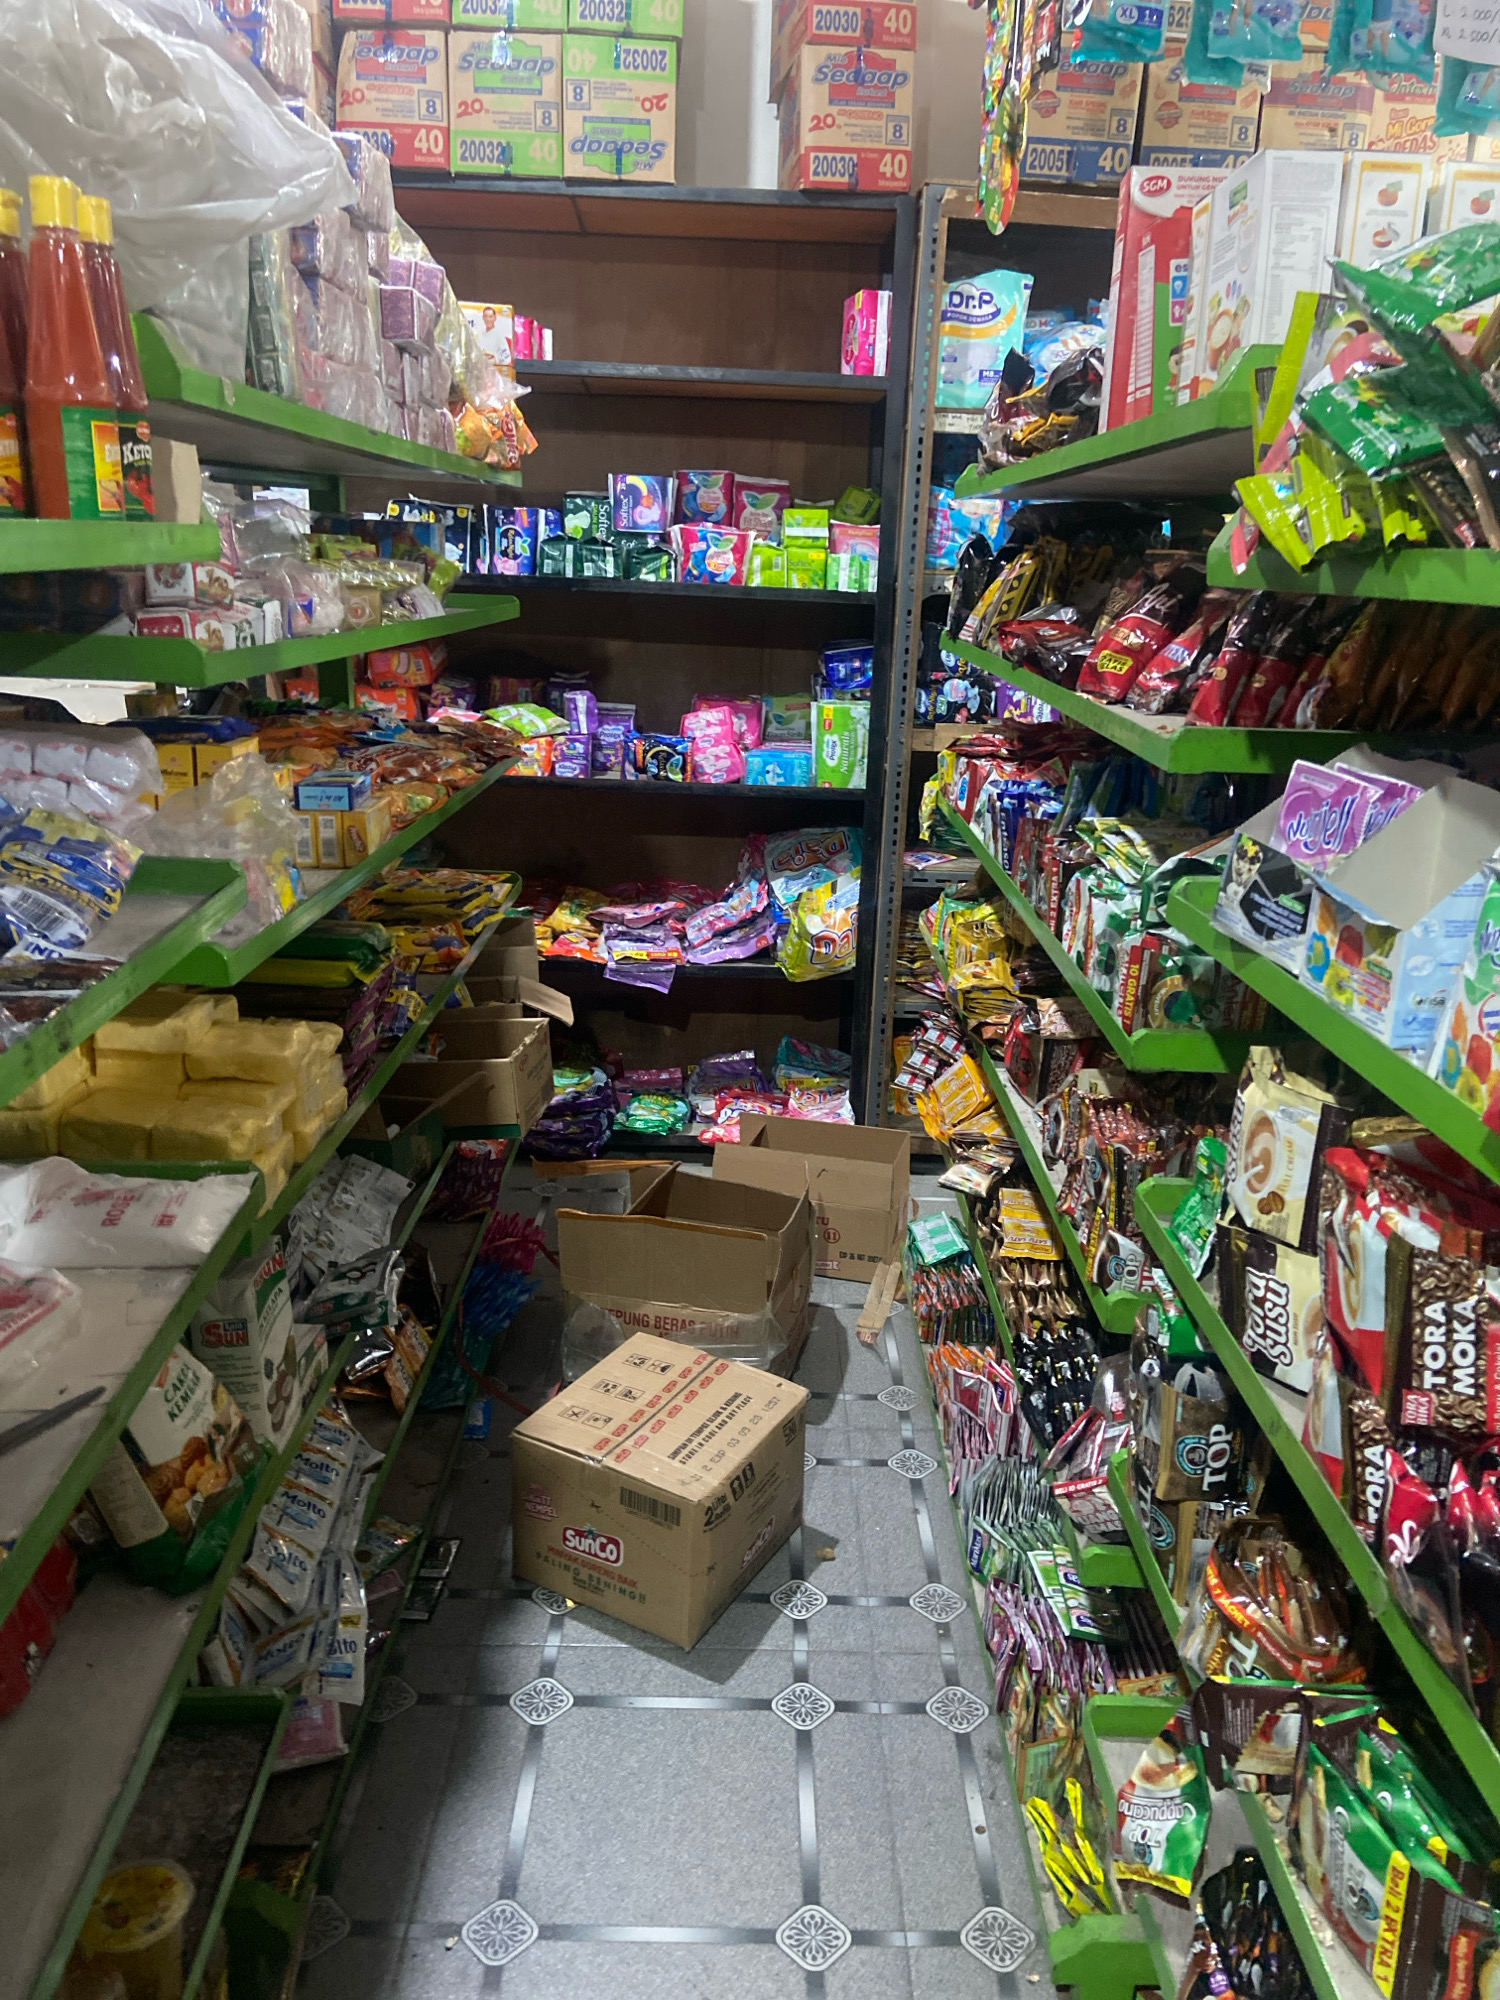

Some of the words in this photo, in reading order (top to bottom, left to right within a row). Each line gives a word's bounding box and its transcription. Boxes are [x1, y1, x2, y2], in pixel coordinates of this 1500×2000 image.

[815, 9, 859, 33] 20030
[884, 8, 911, 34] 40
[1120, 5, 1137, 18] XL
[352, 45, 440, 66] edaap
[622, 49, 667, 72] 20032
[812, 64, 910, 91] Sedaap
[425, 98, 437, 115] 8
[573, 85, 583, 103] 8
[640, 93, 668, 112] 20
[456, 98, 484, 118] 20
[541, 109, 552, 127] 8
[808, 114, 836, 132] 20
[892, 123, 903, 139] 8
[1116, 117, 1127, 133] 8
[1237, 125, 1249, 141] 8
[414, 129, 444, 154] 40
[459, 139, 504, 163] 20032
[528, 138, 558, 162] 40
[569, 135, 667, 161] Sedaap
[1349, 131, 1359, 148] 8
[812, 154, 856, 177] 20030
[879, 153, 908, 178] 40
[1098, 147, 1129, 172] 40
[1142, 178, 1168, 191] SGM
[841, 731, 850, 774] Naturals
[1050, 877, 1060, 907] EXTRA
[1123, 977, 1137, 1019] GRATIS
[653, 1316, 696, 1331] BERAS
[1263, 1279, 1293, 1367] susu
[1423, 1301, 1447, 1389] TORA
[1452, 1295, 1479, 1396] MOKA
[1405, 1394, 1419, 1424] TORA
[1416, 1396, 1430, 1425] BIKA
[295, 1453, 341, 1477] Molto
[1203, 1424, 1233, 1491] TOP
[1366, 1444, 1386, 1525] TORA
[280, 1490, 327, 1519] Molto
[565, 1529, 618, 1562] SunCo
[1118, 1799, 1197, 1824] Cappuccino
[1128, 1823, 1162, 1848] TOP
[1389, 1864, 1406, 1900] Beli
[1386, 1904, 1402, 1922] 2
